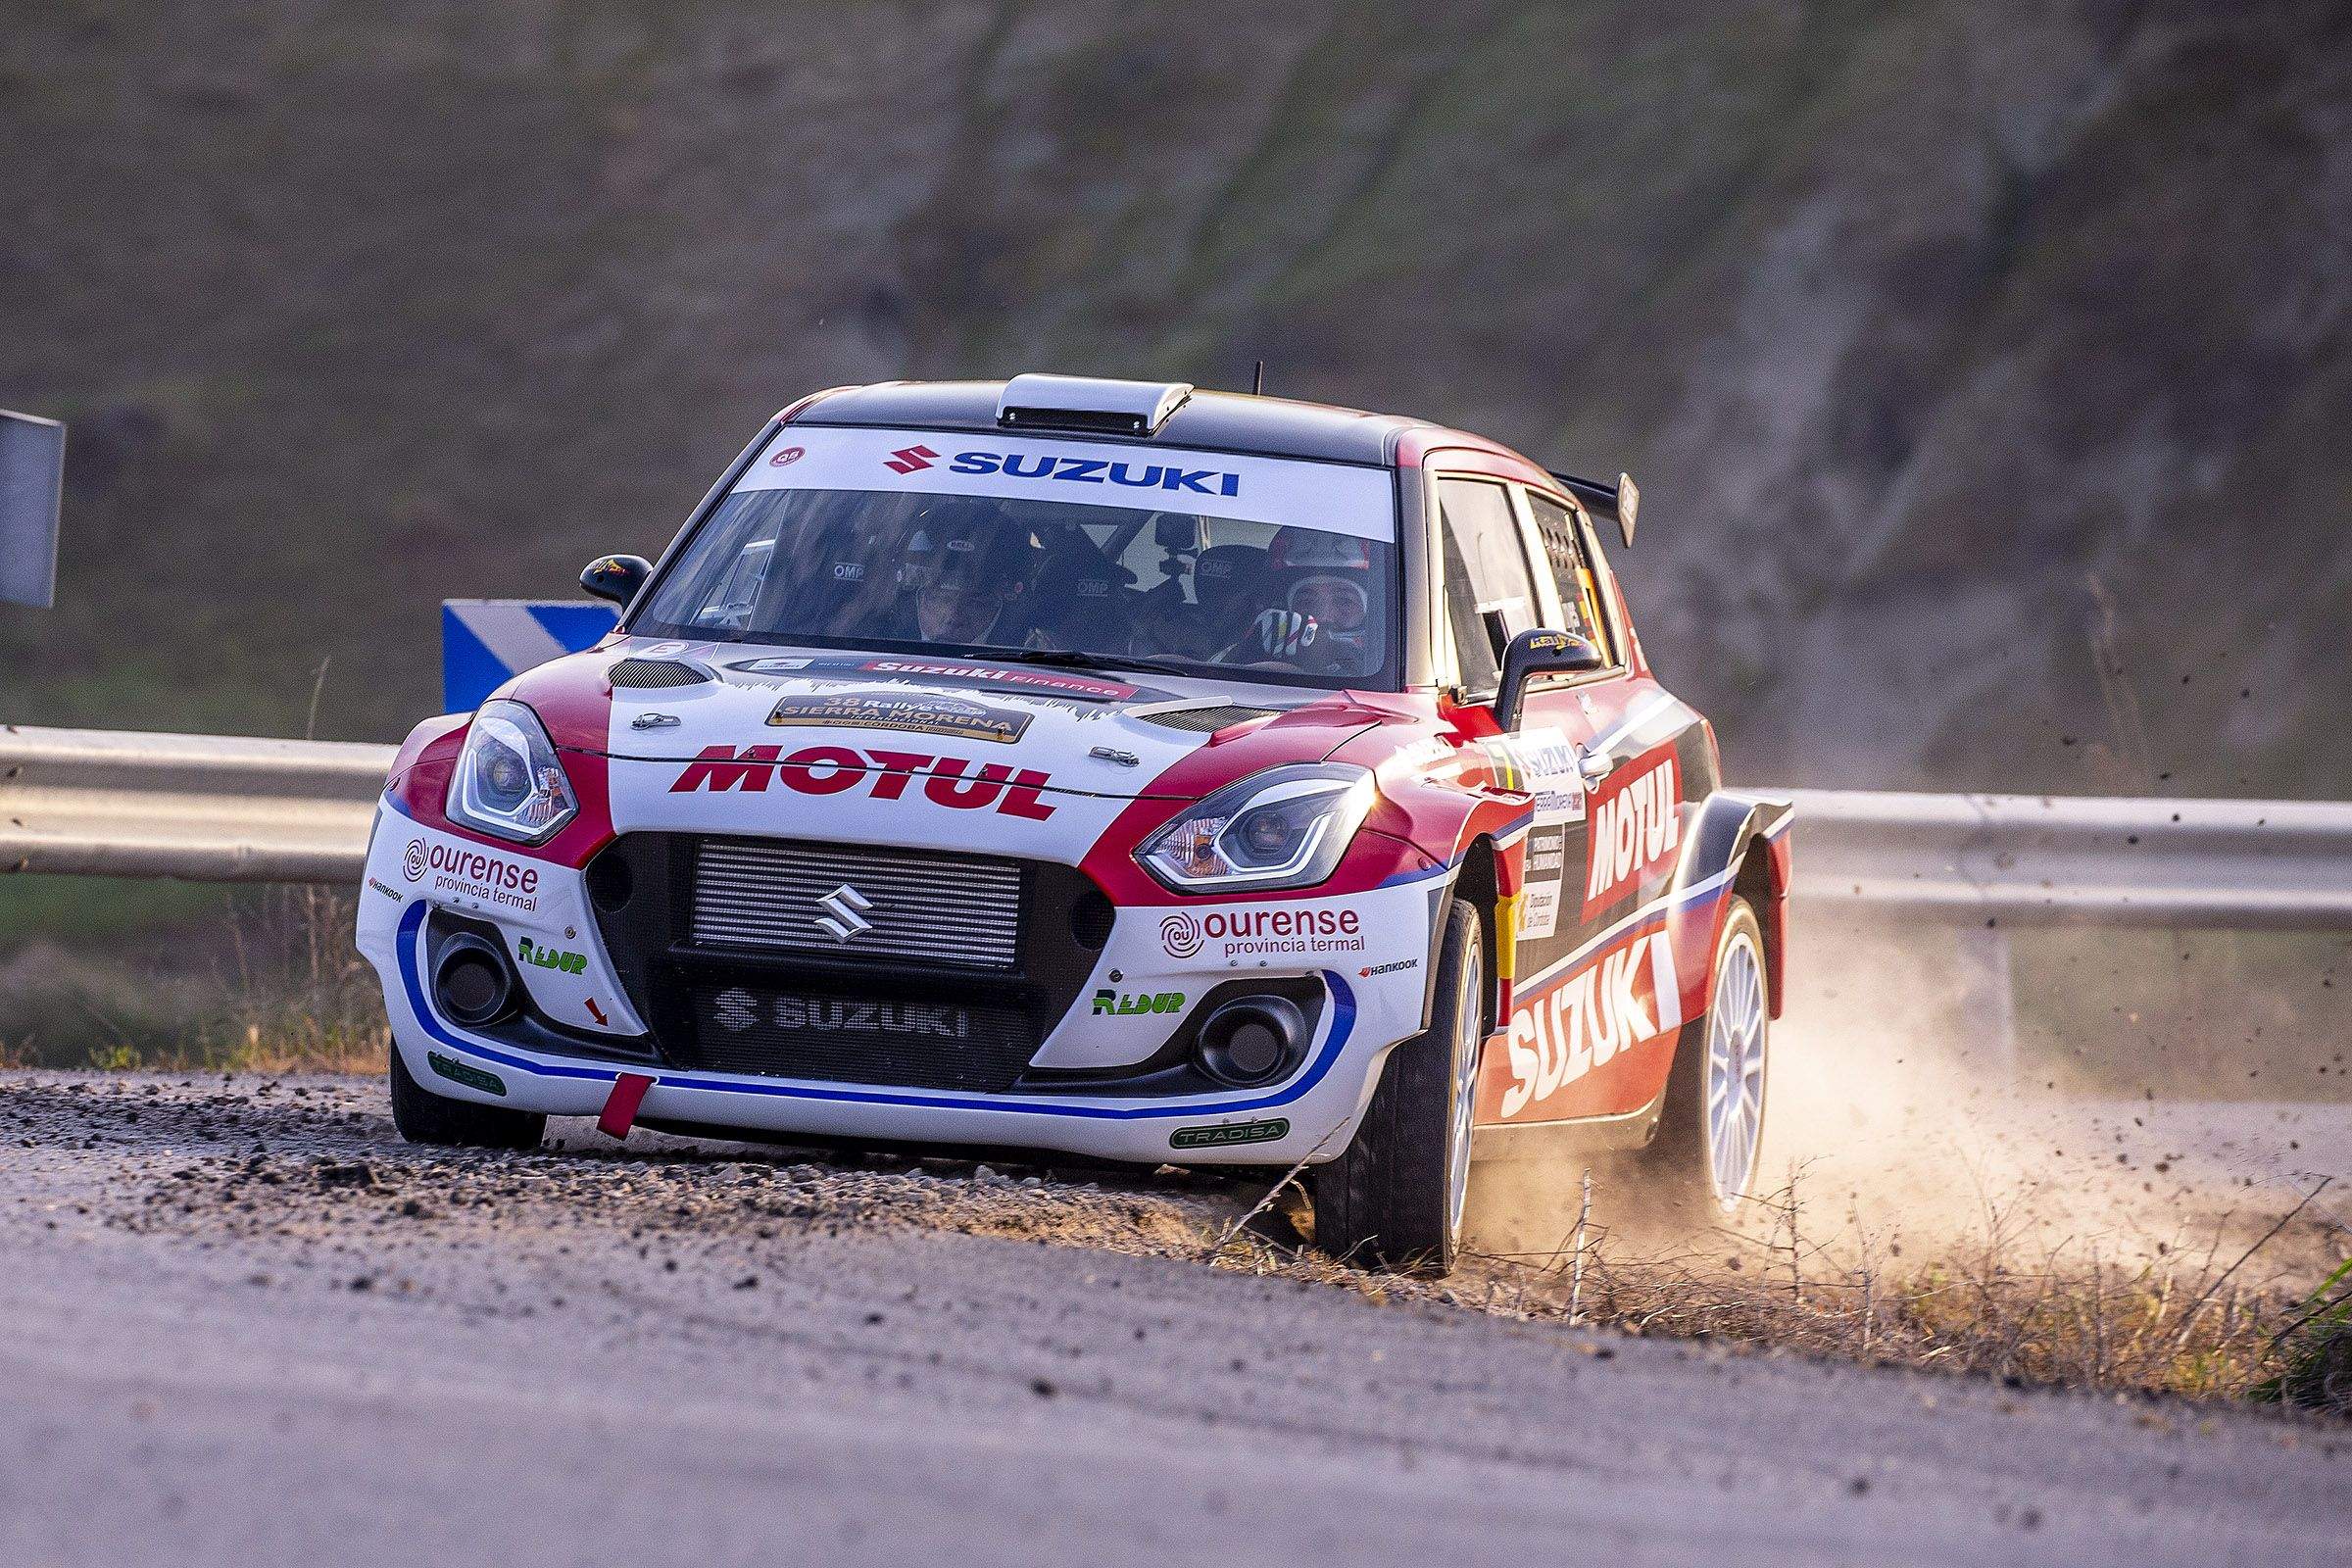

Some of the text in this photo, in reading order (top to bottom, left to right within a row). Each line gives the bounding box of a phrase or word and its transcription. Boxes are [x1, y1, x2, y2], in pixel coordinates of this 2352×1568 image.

[948, 451, 1240, 497] SUZUKI
[834, 564, 864, 579] OMP
[782, 706, 1015, 731] SIERRA MORENA
[823, 697, 861, 707] 38
[668, 745, 1058, 821] MOTUL
[1587, 758, 1681, 902] MOTUL
[429, 844, 539, 894] ourense
[434, 874, 538, 913] provincia termal
[1203, 907, 1360, 939] ourense
[1224, 935, 1366, 958] provincia termal
[772, 996, 969, 1038] SUZUKI
[1500, 929, 1683, 1119] SUZUKI
[1179, 1123, 1281, 1145] TRADISA
